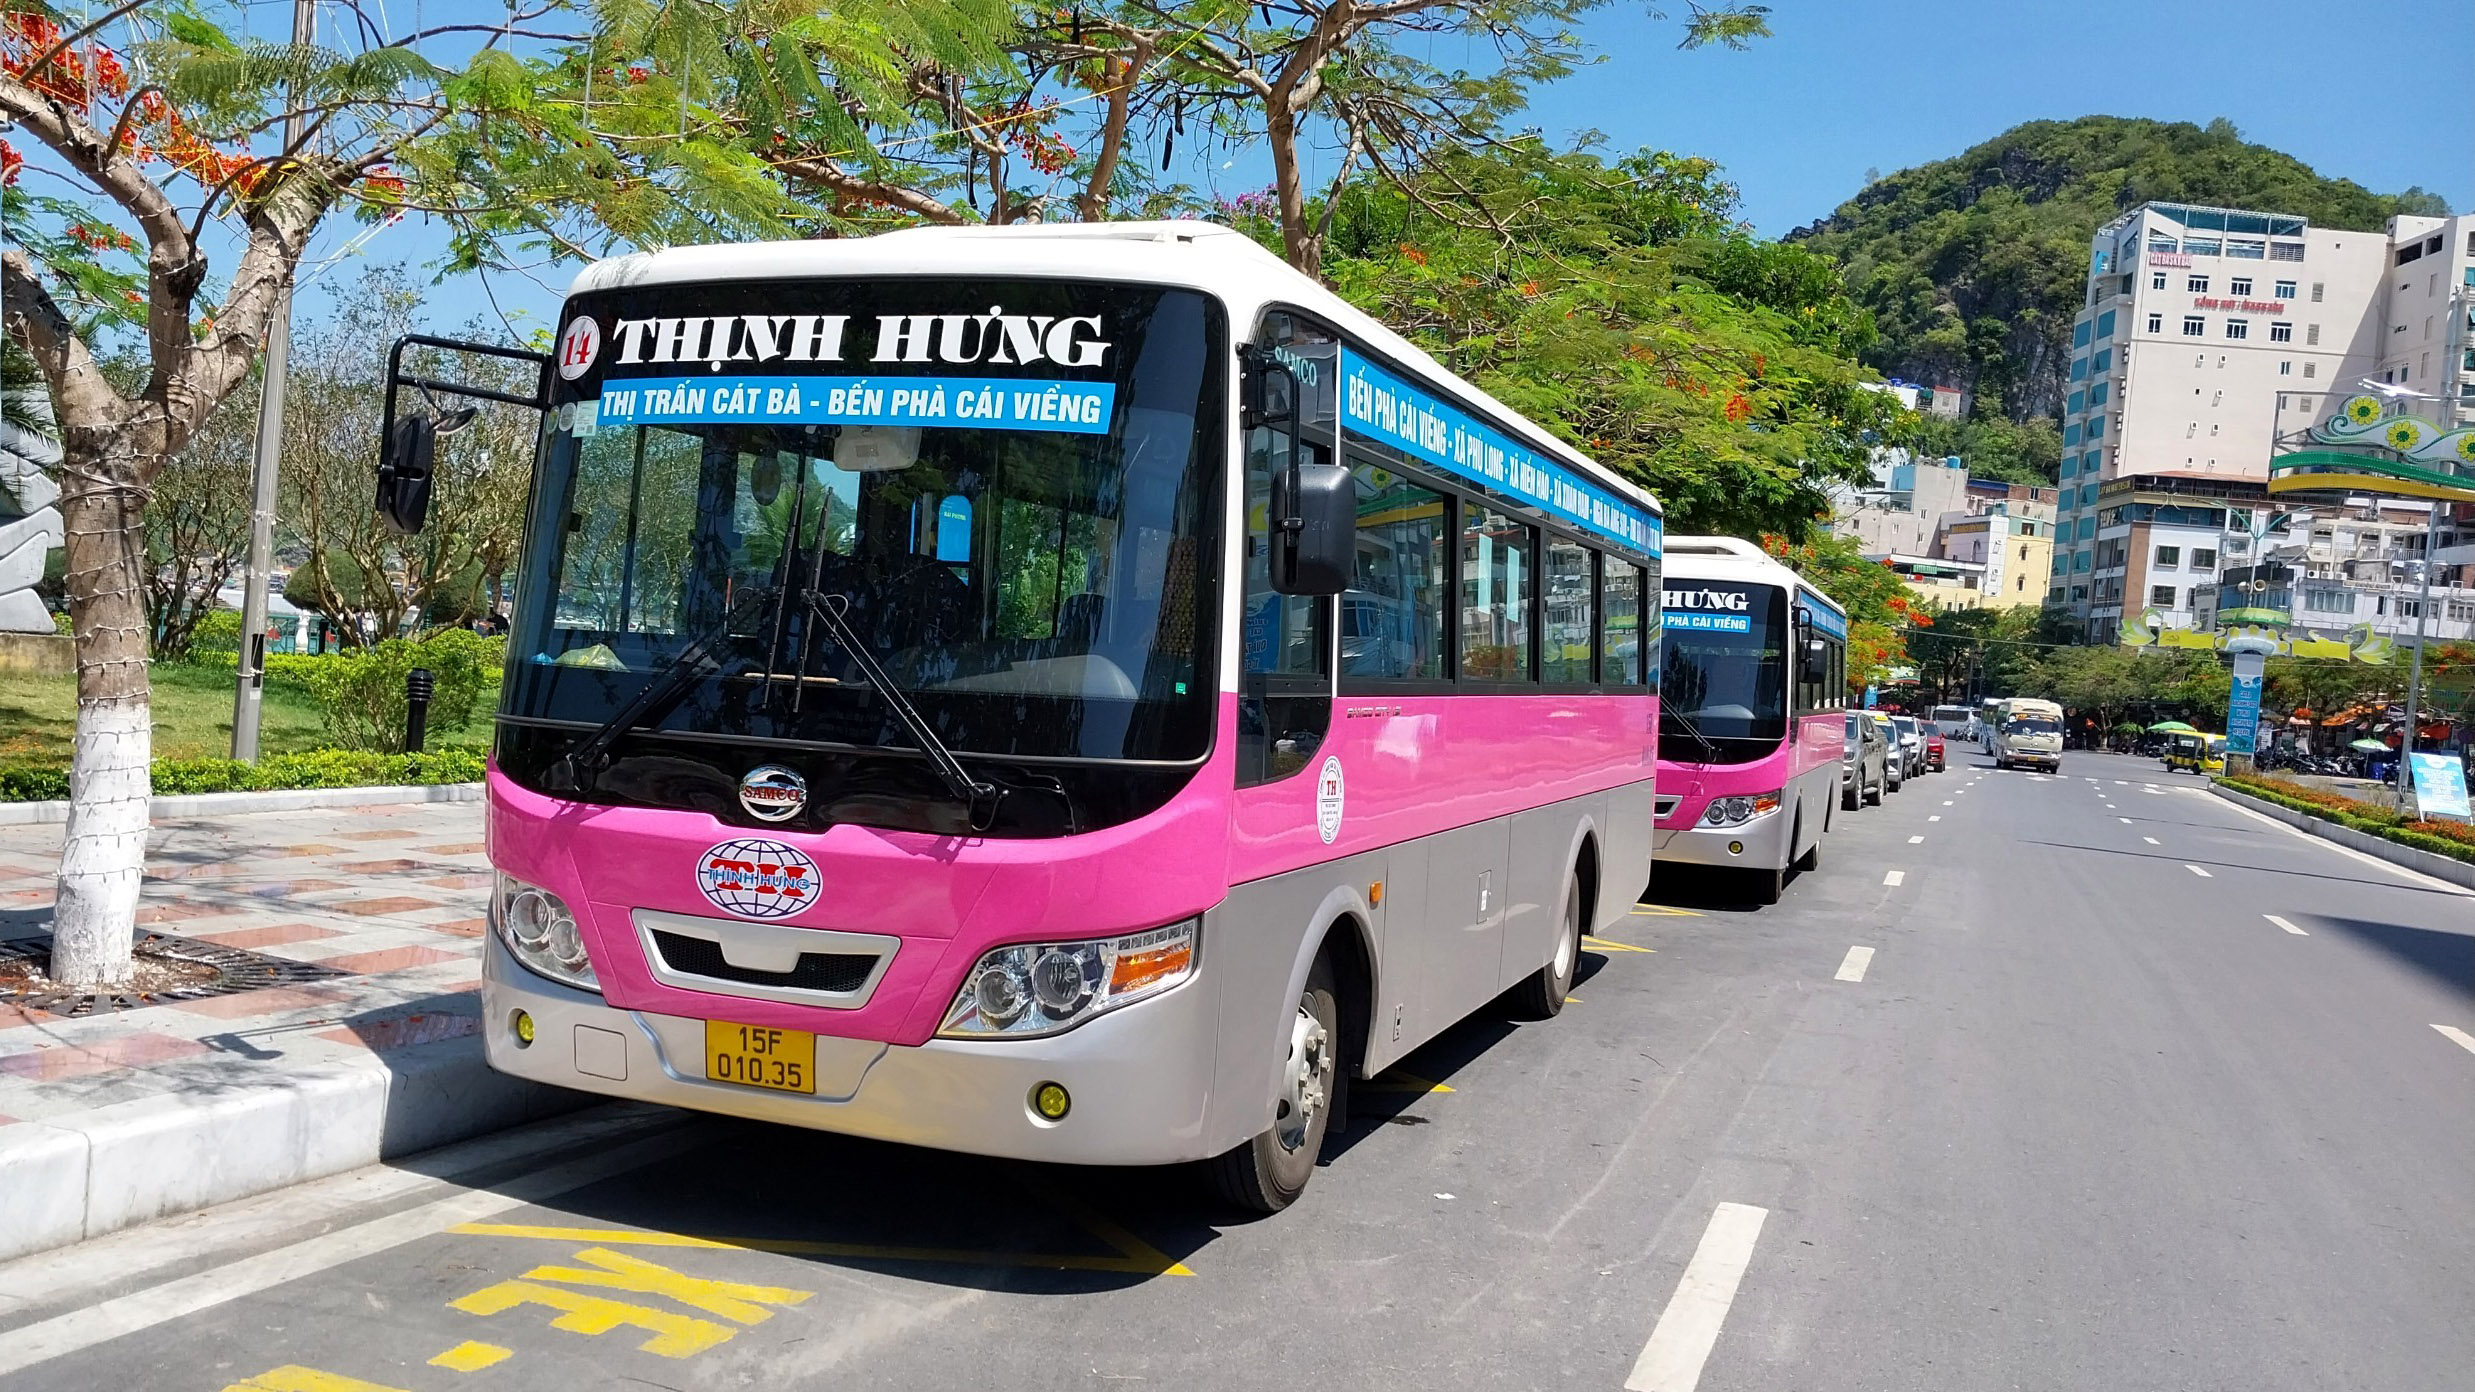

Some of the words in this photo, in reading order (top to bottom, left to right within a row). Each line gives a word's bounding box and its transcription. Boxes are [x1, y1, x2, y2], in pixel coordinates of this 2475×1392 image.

[563, 331, 591, 367] 14
[613, 315, 850, 372] THỊNH
[869, 305, 1112, 367] HƯNG
[603, 391, 637, 421] THỊ
[644, 380, 706, 415] TRẤN
[712, 383, 762, 415] CÁT
[766, 383, 800, 414] BÀ
[828, 379, 883, 416] BẾN
[891, 384, 946, 417] PHÀ
[955, 386, 1005, 419] CÁI
[1014, 384, 1102, 424] VIỀNG
[1349, 366, 1372, 423] BẾN
[1375, 388, 1397, 434] PHÀ
[1400, 397, 1417, 443] CÁI
[1485, 443, 1504, 482] LONG
[1662, 588, 1750, 611] HƯNG
[1667, 614, 1689, 627] PHÀ
[1692, 616, 1711, 628] CÁI
[744, 786, 800, 802] SAMCO
[1327, 780, 1337, 796] TH
[740, 1026, 782, 1056] 15F
[718, 1053, 802, 1088] 010.35
